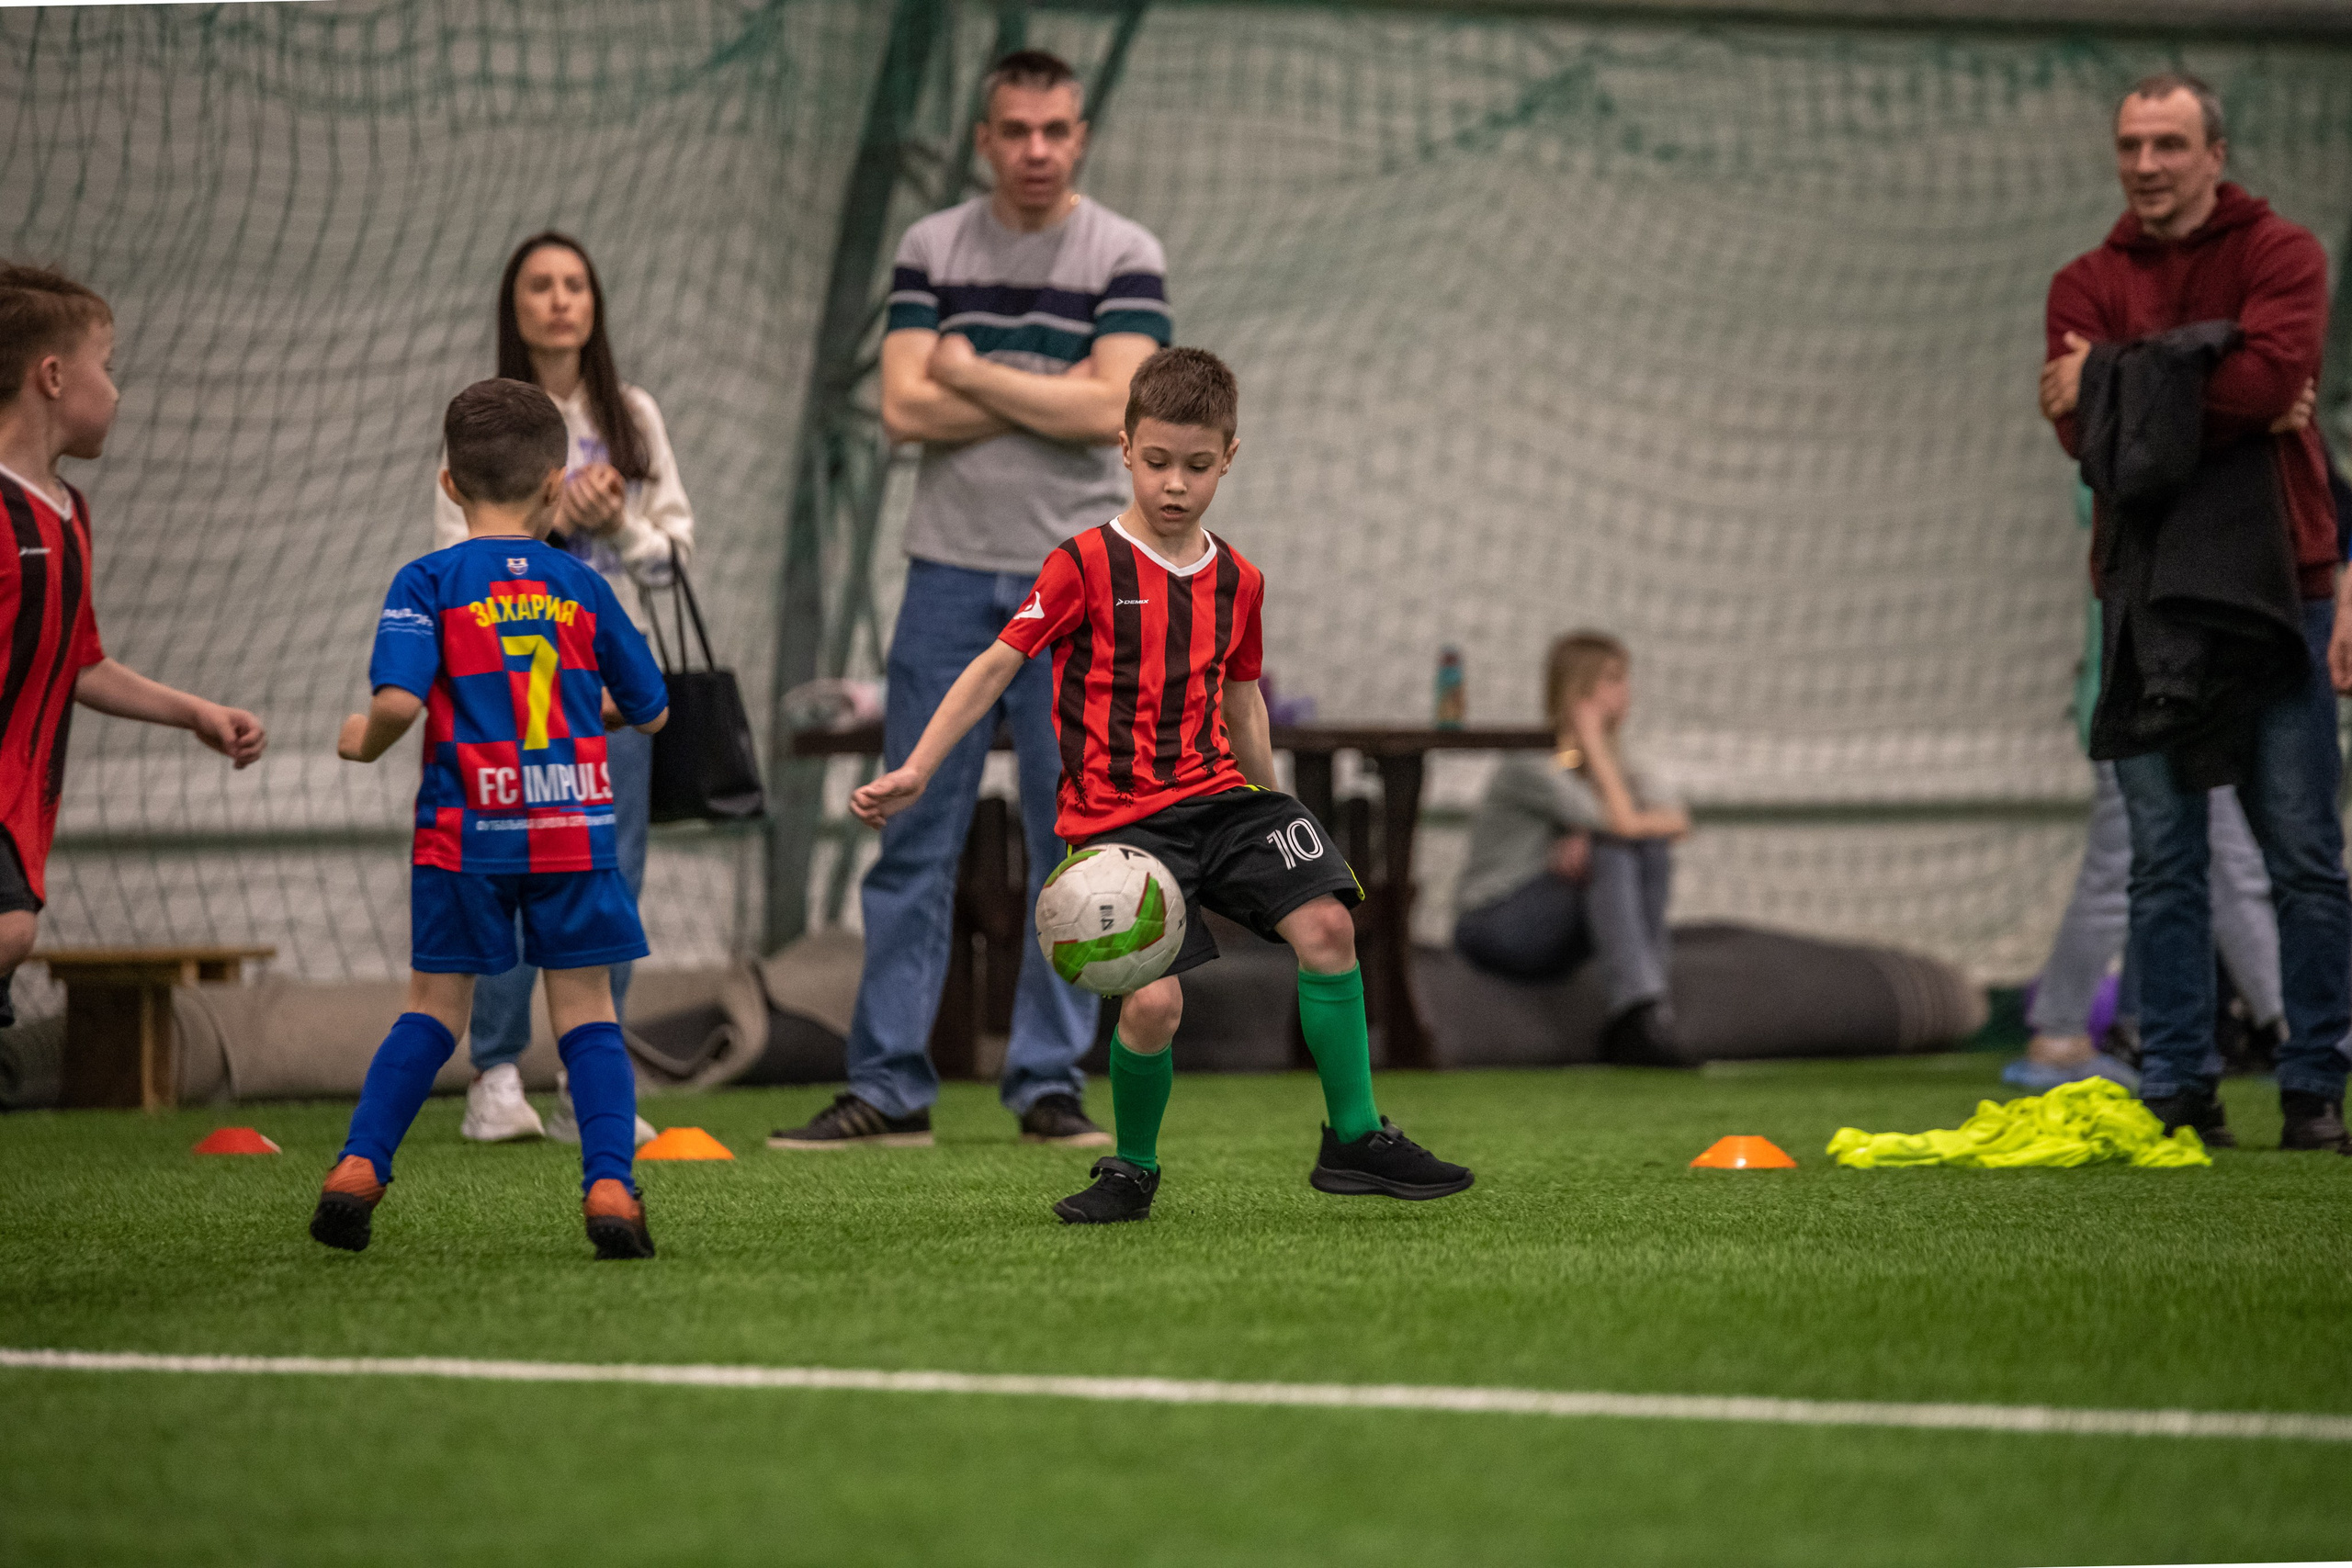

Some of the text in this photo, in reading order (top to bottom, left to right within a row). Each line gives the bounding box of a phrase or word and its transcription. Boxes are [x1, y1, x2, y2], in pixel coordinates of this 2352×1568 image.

[469, 593, 579, 627] ЗАХАРИЯ
[501, 634, 559, 750] 7
[477, 766, 518, 806] FC
[1266, 818, 1324, 871] 10
